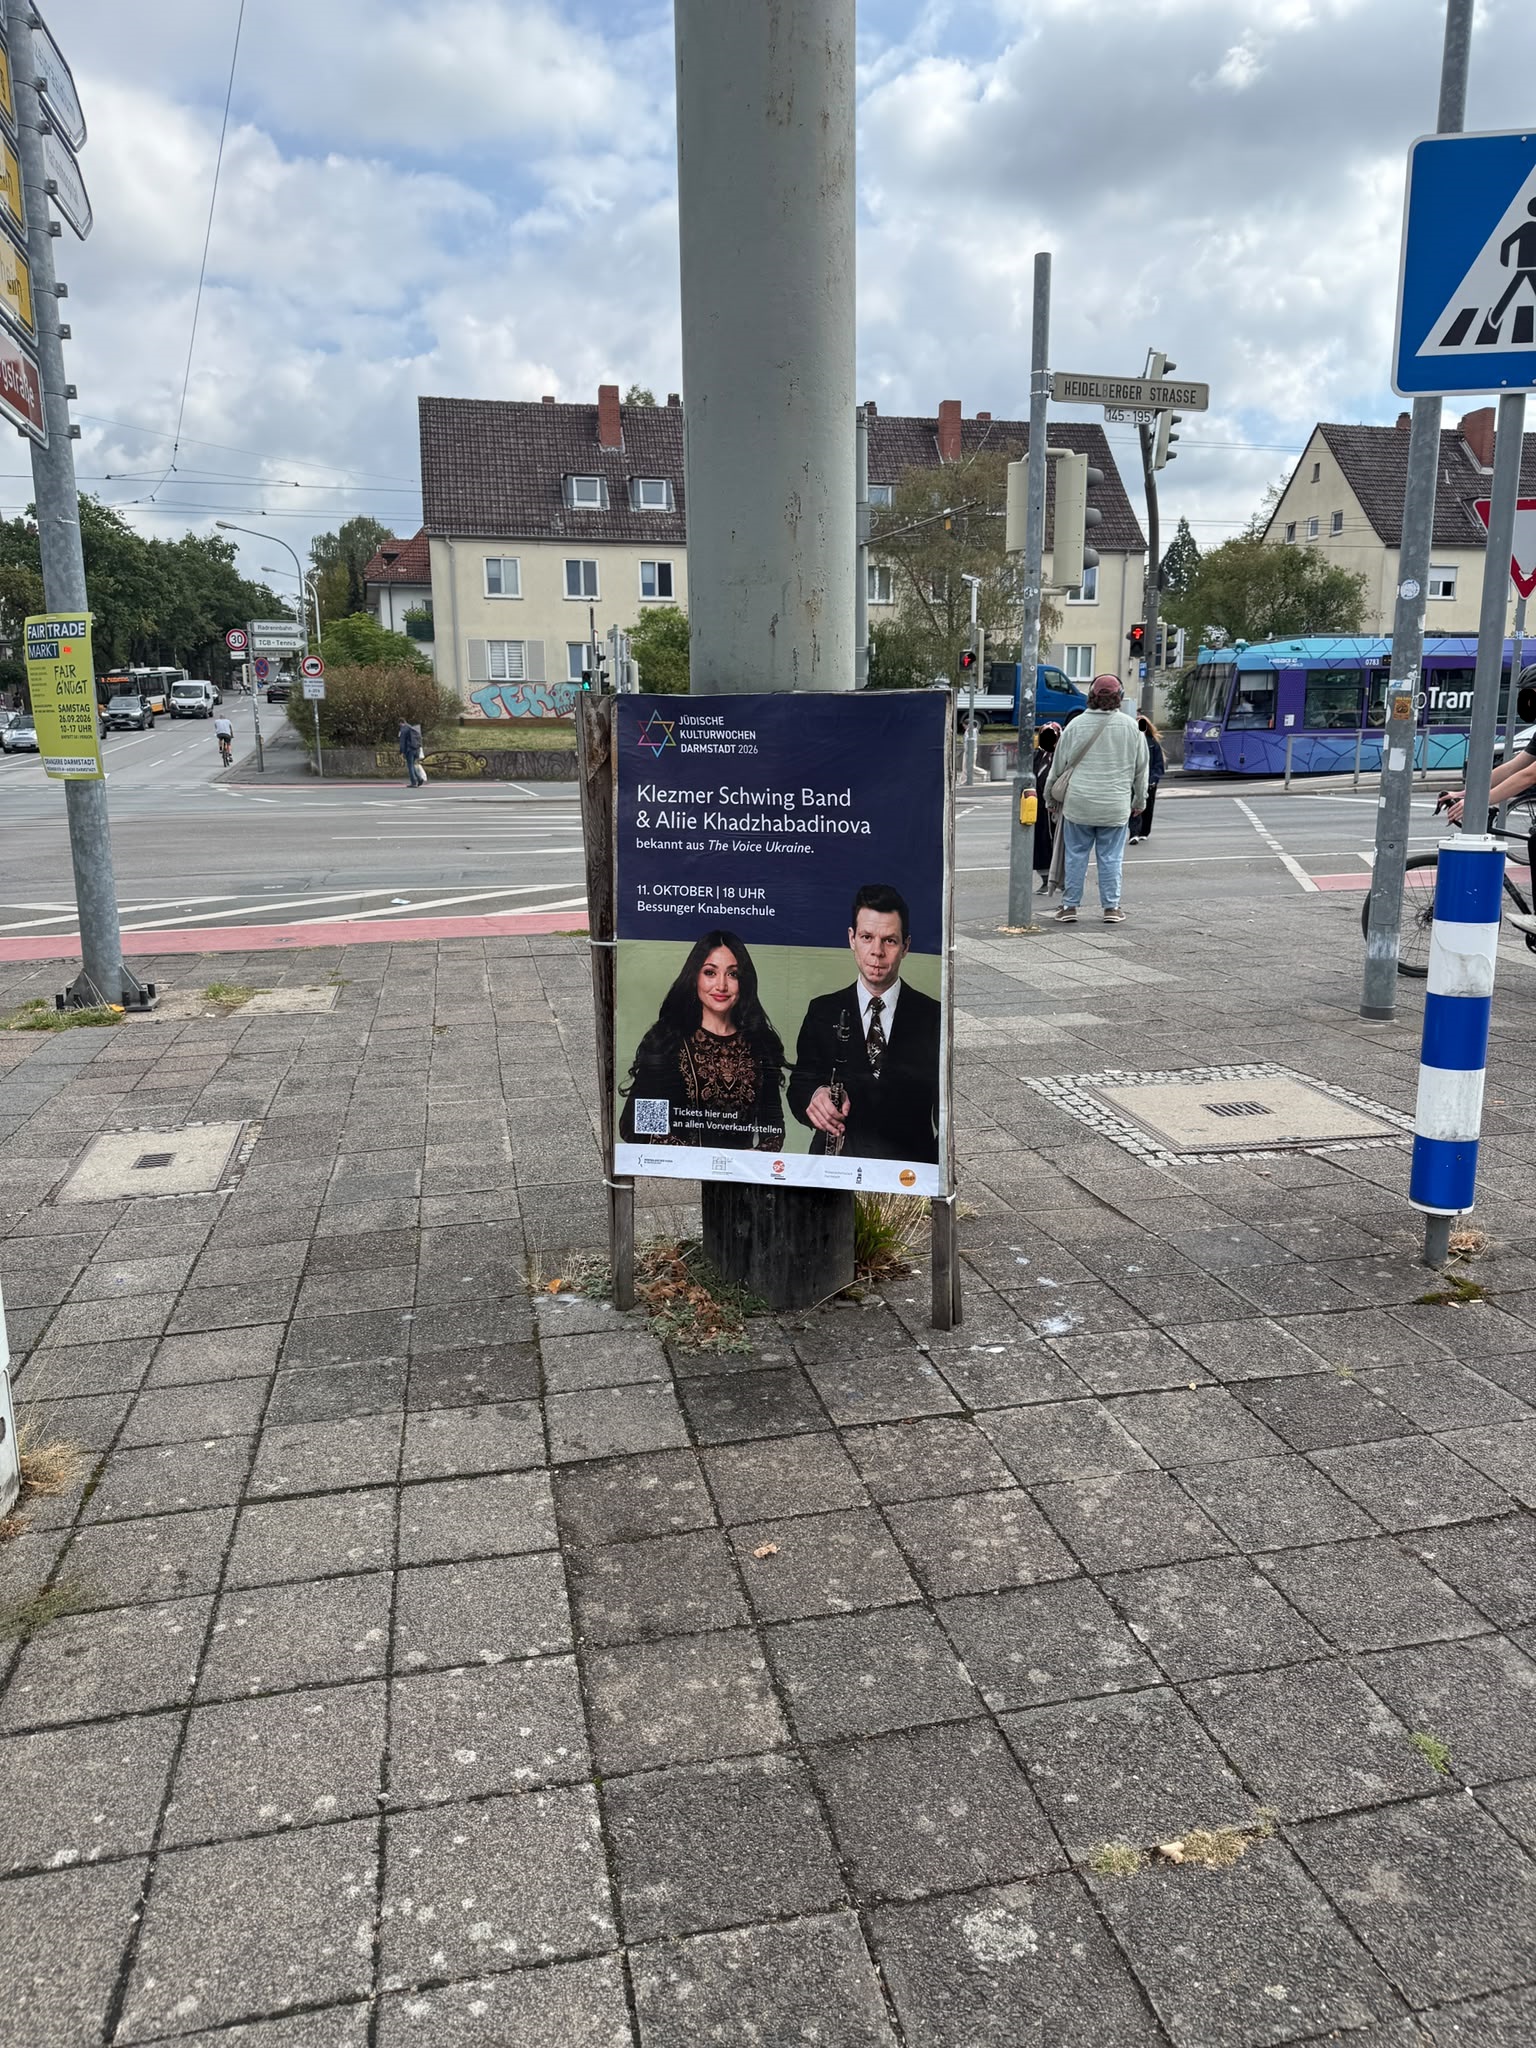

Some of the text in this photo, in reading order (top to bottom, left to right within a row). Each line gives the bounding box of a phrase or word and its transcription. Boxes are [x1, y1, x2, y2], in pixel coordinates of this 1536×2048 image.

[0, 359, 36, 408] gstraße
[1064, 380, 1197, 404] HEIDELBERGER STRASSE
[231, 634, 243, 645] 30
[28, 643, 58, 658] MARKT
[1365, 658, 1380, 666] 0783
[54, 664, 77, 680] FAIR
[58, 703, 91, 713] SAMSTAG
[59, 714, 91, 723] 26.09.2026
[678, 714, 725, 726] JÜDISCHE
[77, 724, 92, 733] UHR
[679, 729, 756, 740] KULTURWOCHEN
[680, 743, 759, 754] DARMSTADT 2026
[64, 758, 95, 766] DARMSTADT
[637, 784, 851, 811] Klezmer Schwing Band
[636, 810, 871, 834] & Aliie Khadzhabadinova
[636, 837, 815, 854] bekannt aus The Voice Ukraine.
[636, 884, 650, 896] 11.
[653, 884, 714, 898] OKTOBER
[722, 887, 736, 899] 18
[738, 887, 766, 900] UHR
[637, 900, 776, 917] Bessunger Knabenschule
[672, 1107, 739, 1120] Tickets hier und
[672, 1120, 783, 1135] an allen Vorverkaufsstellen
